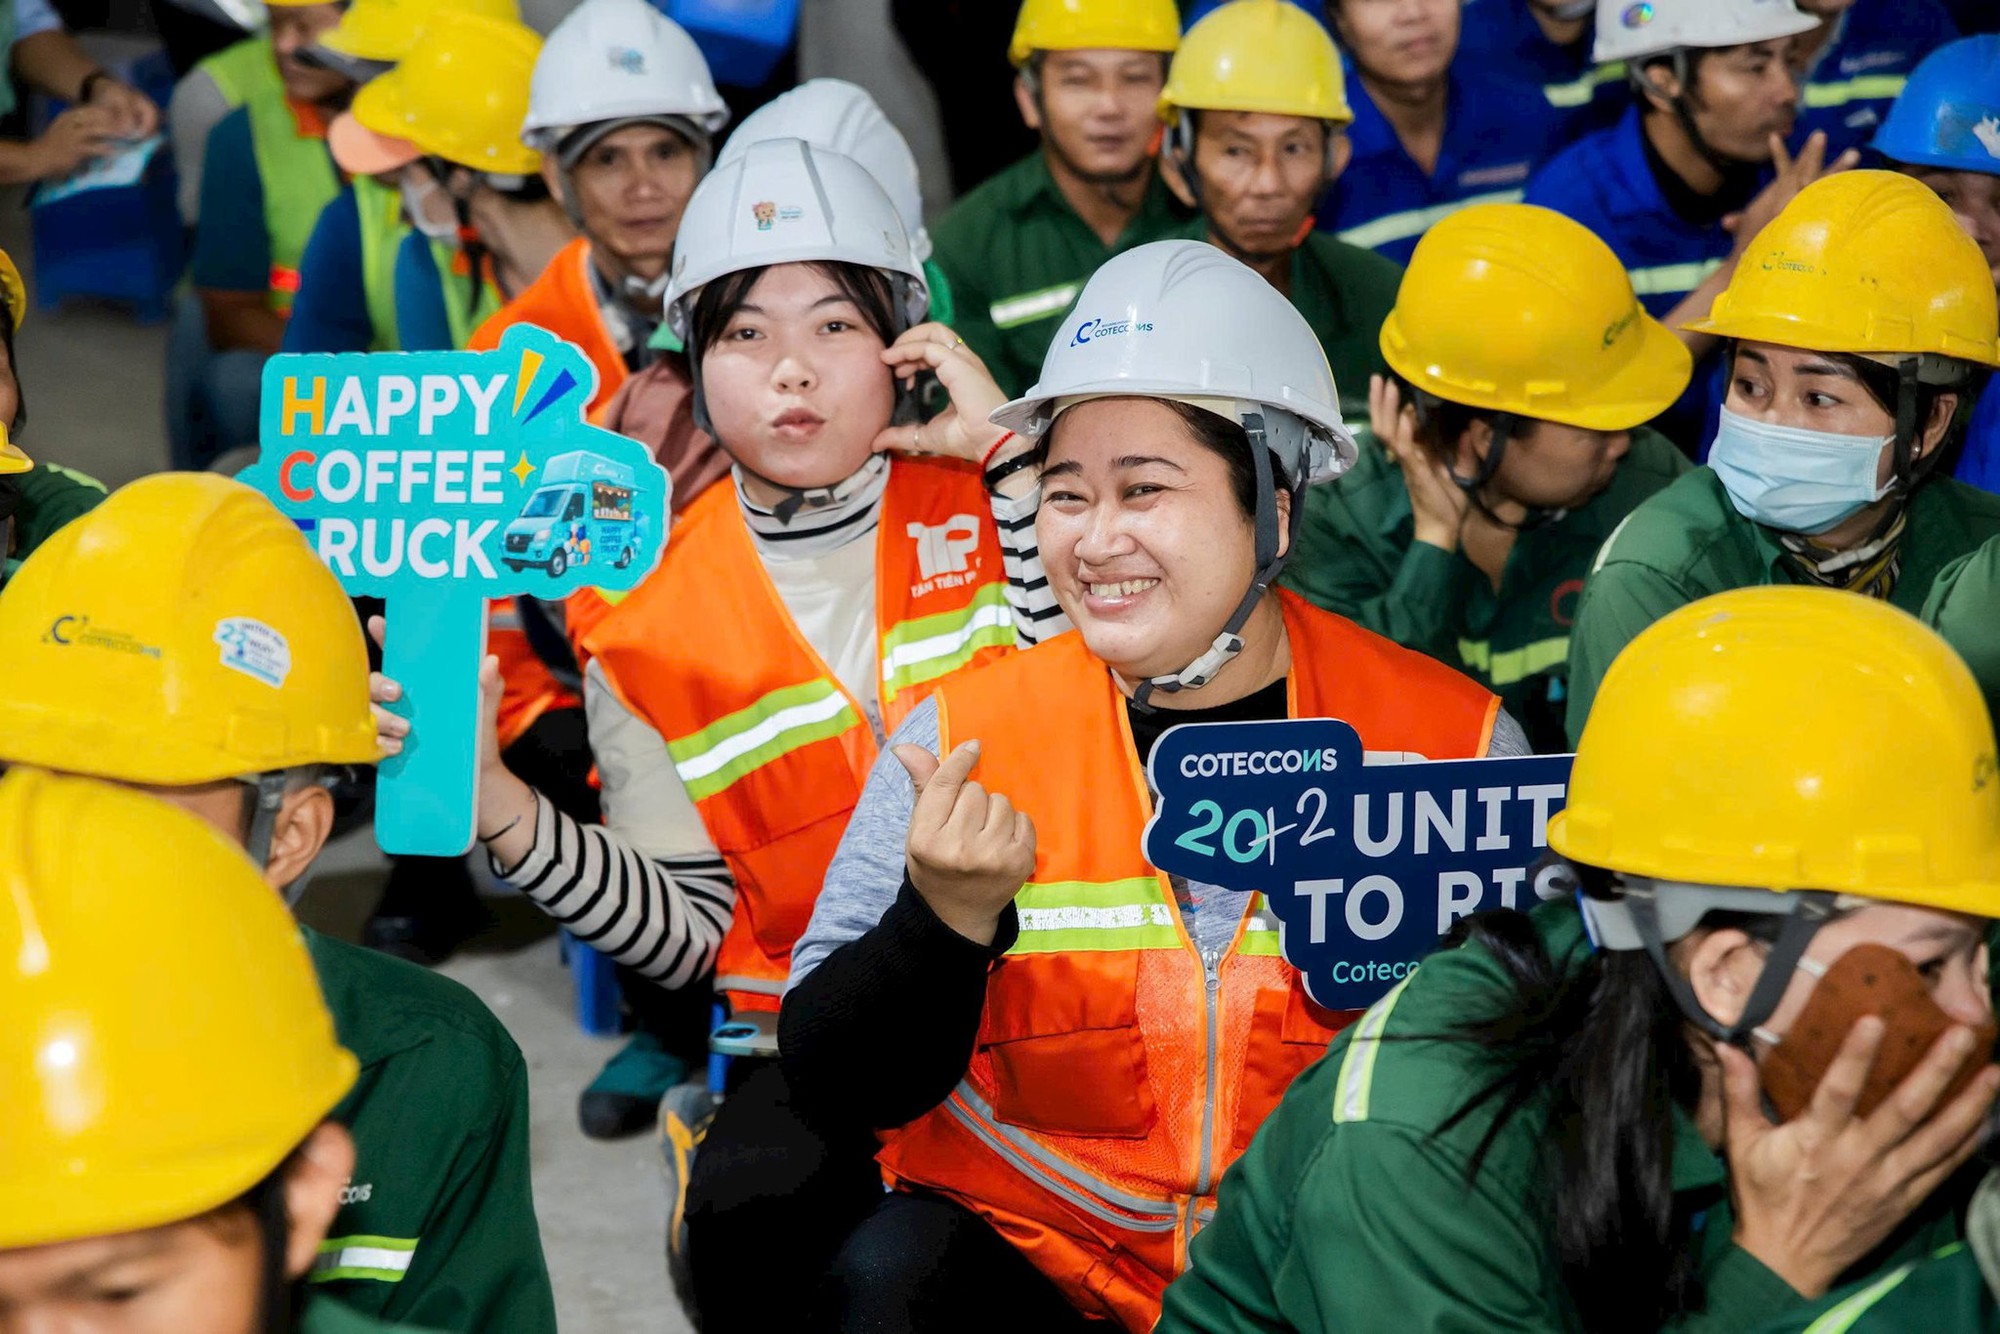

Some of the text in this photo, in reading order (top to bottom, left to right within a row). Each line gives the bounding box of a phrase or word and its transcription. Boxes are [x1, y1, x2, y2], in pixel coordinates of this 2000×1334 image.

[281, 374, 509, 436] HAPPY
[279, 450, 506, 505] COFFEE
[1294, 875, 1405, 944] TO
